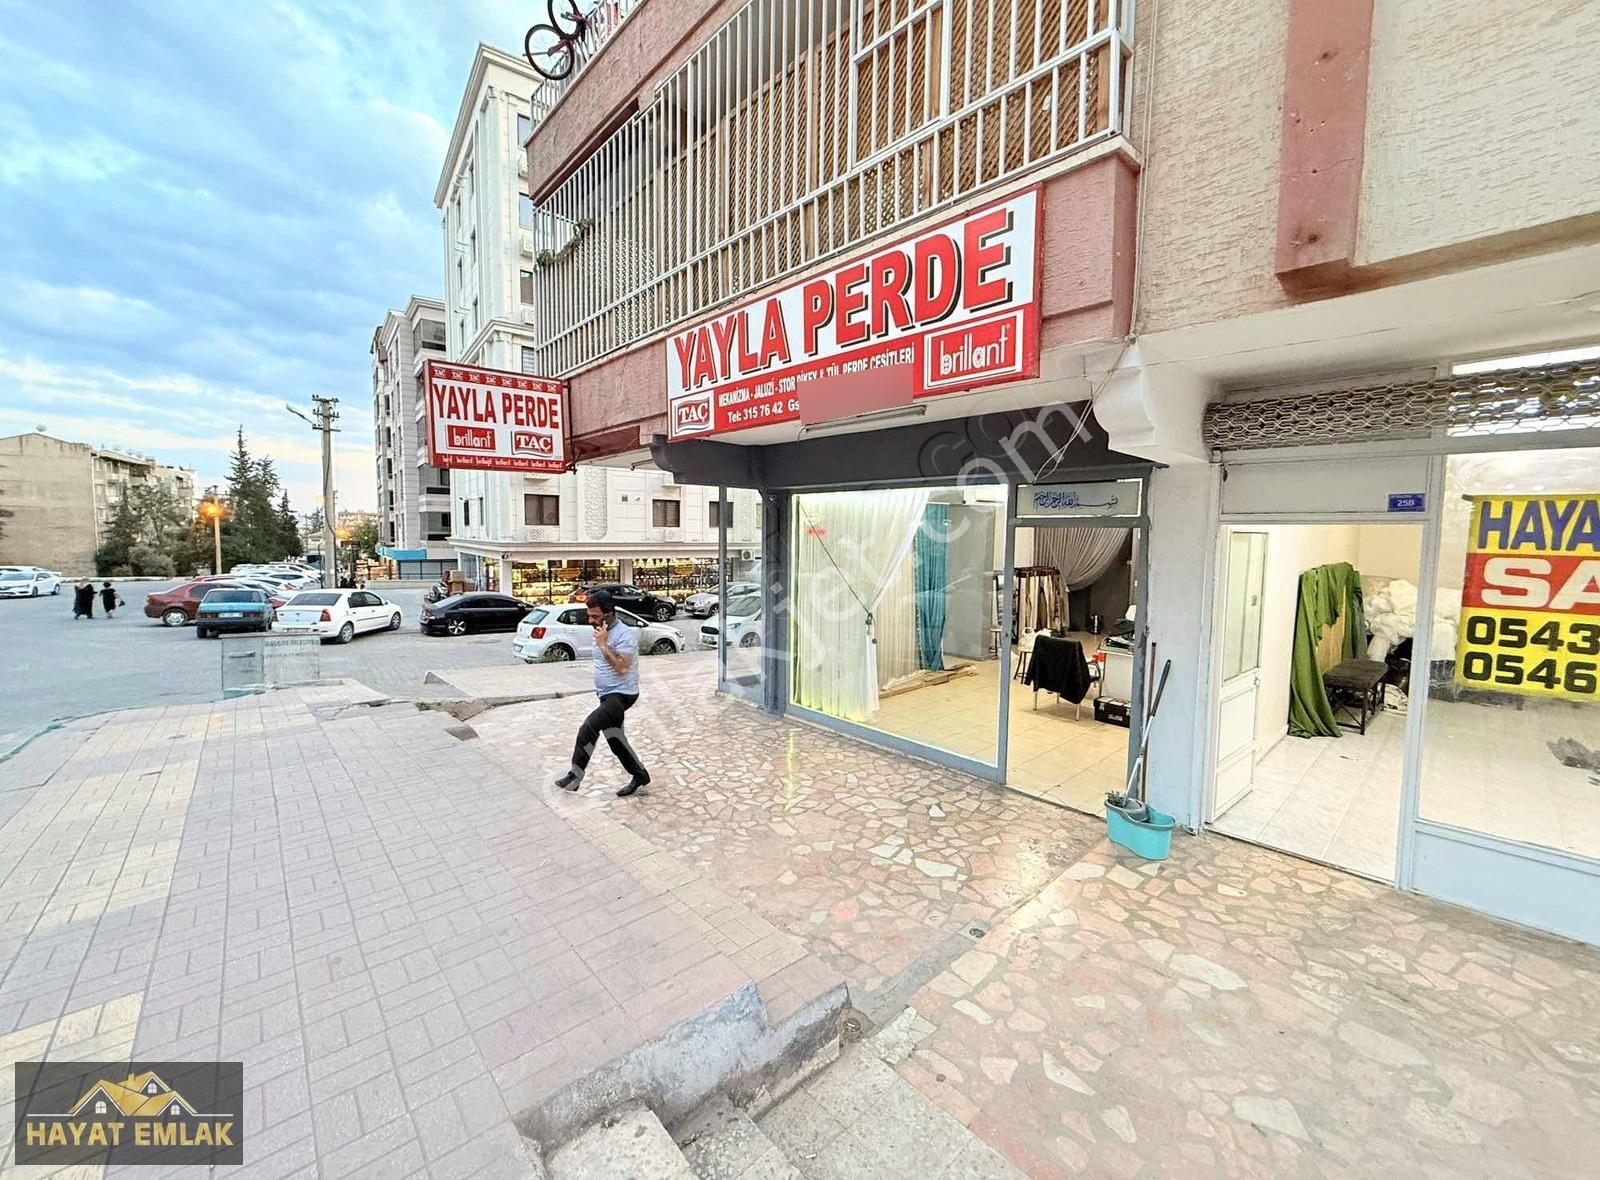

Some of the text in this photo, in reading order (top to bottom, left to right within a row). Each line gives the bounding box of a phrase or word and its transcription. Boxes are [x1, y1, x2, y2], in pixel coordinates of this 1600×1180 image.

[674, 208, 1013, 391] YAYLA PERDE
[940, 323, 1008, 376] brillant
[778, 376, 796, 395] STOR
[433, 383, 560, 429] YAYLA PERDE
[679, 403, 709, 423] TAÇ
[727, 411, 742, 424] Tel:
[743, 406, 759, 421] 315
[760, 403, 771, 417] 76
[772, 401, 784, 415] 42
[453, 427, 493, 449] brillant
[1466, 616, 1600, 655] 0543
[1463, 651, 1597, 694] 0546
